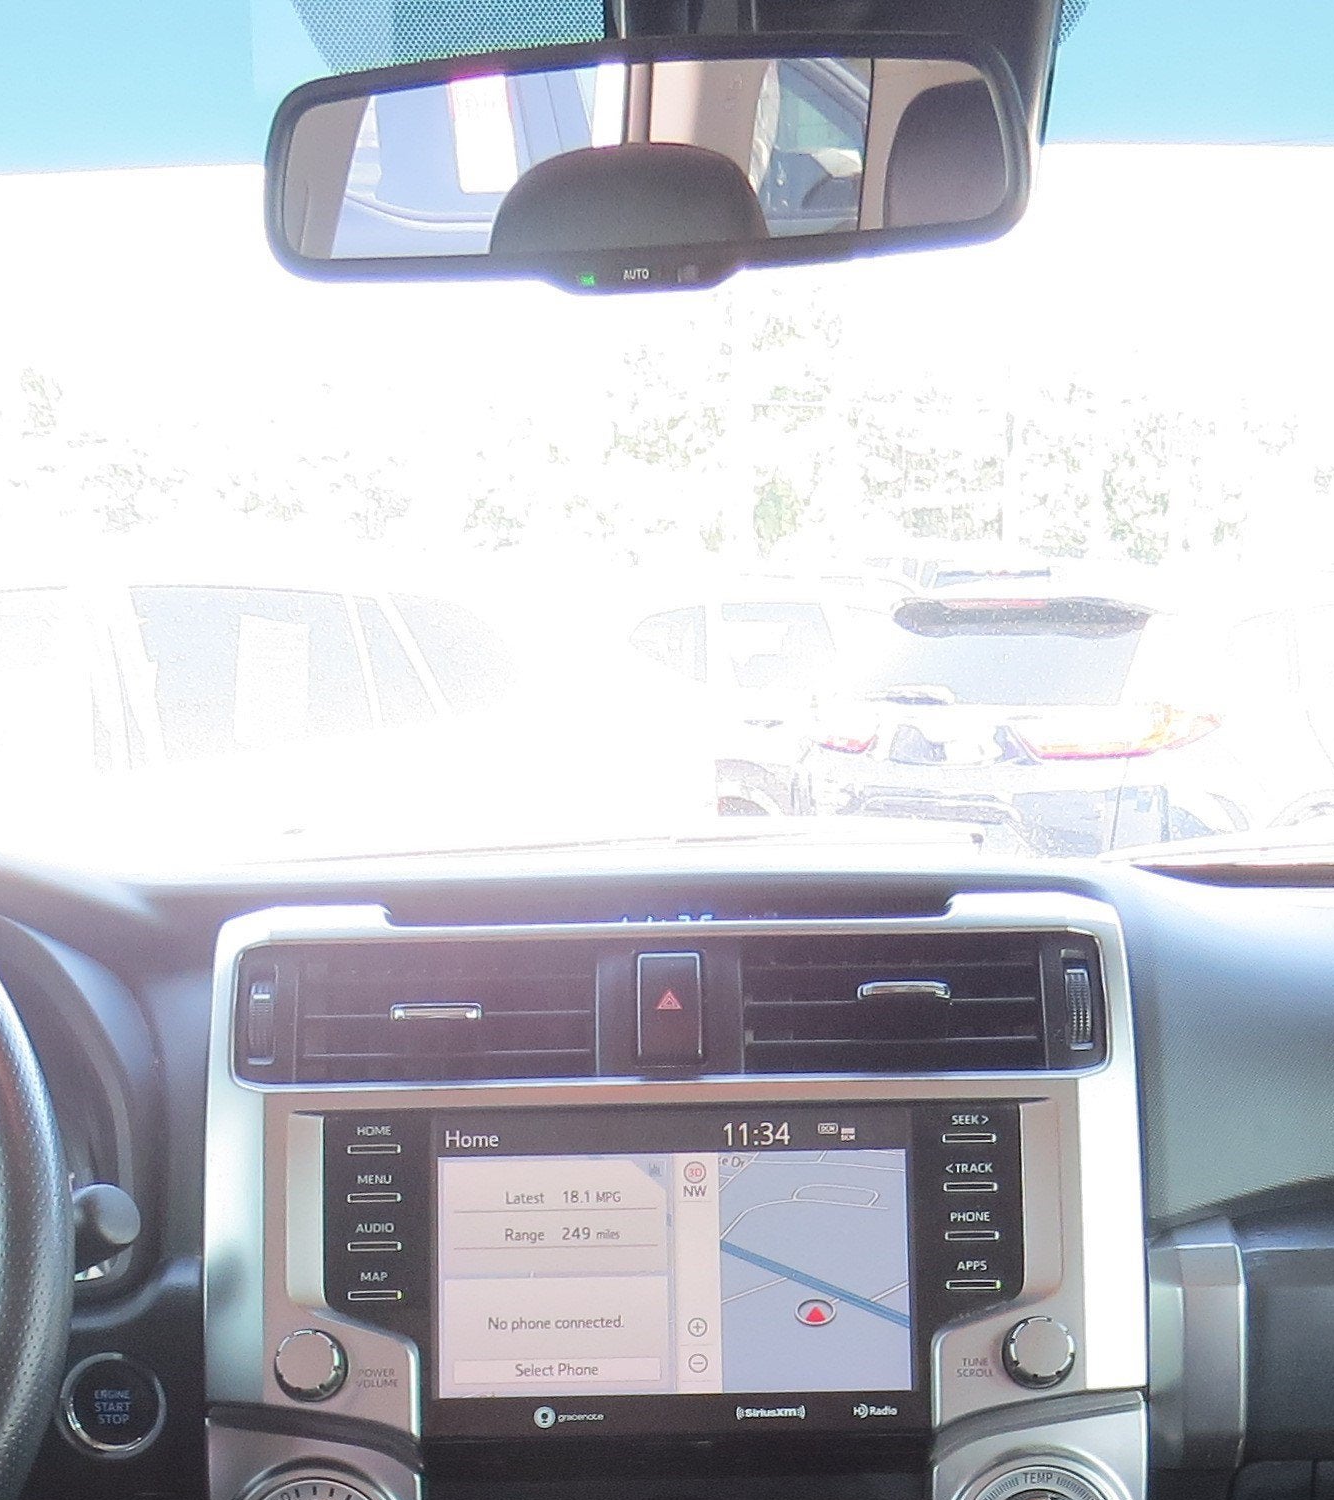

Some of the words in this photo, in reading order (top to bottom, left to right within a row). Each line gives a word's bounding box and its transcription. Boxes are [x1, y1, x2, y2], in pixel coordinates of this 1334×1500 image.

[623, 268, 649, 280] AUTO
[952, 1115, 979, 1125] SEEK
[357, 1126, 392, 1137] HOME
[723, 1121, 790, 1147] 11:34
[445, 1130, 499, 1148] Home
[687, 1168, 702, 1177] 3D
[955, 1163, 993, 1173] TRACK
[357, 1174, 392, 1185] MENU
[683, 1185, 707, 1197] NW
[505, 1191, 544, 1205] Latest
[562, 1190, 590, 1203] 18.1
[595, 1191, 621, 1203] MPG
[950, 1211, 990, 1222] PHONE
[355, 1222, 394, 1234] AUDIO
[505, 1228, 544, 1244] Range
[562, 1227, 591, 1240] 249
[596, 1229, 620, 1240] miles
[957, 1260, 987, 1271] APPS
[360, 1271, 388, 1282] MAP
[487, 1317, 508, 1331] No
[511, 1317, 551, 1332] phone
[554, 1315, 625, 1330] connected.
[962, 1358, 989, 1366] TUNE
[358, 1368, 395, 1377] POWER
[514, 1363, 554, 1377] Select
[557, 1363, 599, 1376] Phone
[956, 1368, 993, 1378] SCROLL
[357, 1378, 398, 1388] VOLUME
[94, 1402, 130, 1412] START
[870, 1406, 898, 1416] Radio
[98, 1413, 129, 1424] STOP
[557, 1411, 605, 1423] gracenote
[1022, 1472, 1053, 1485] TEMP
